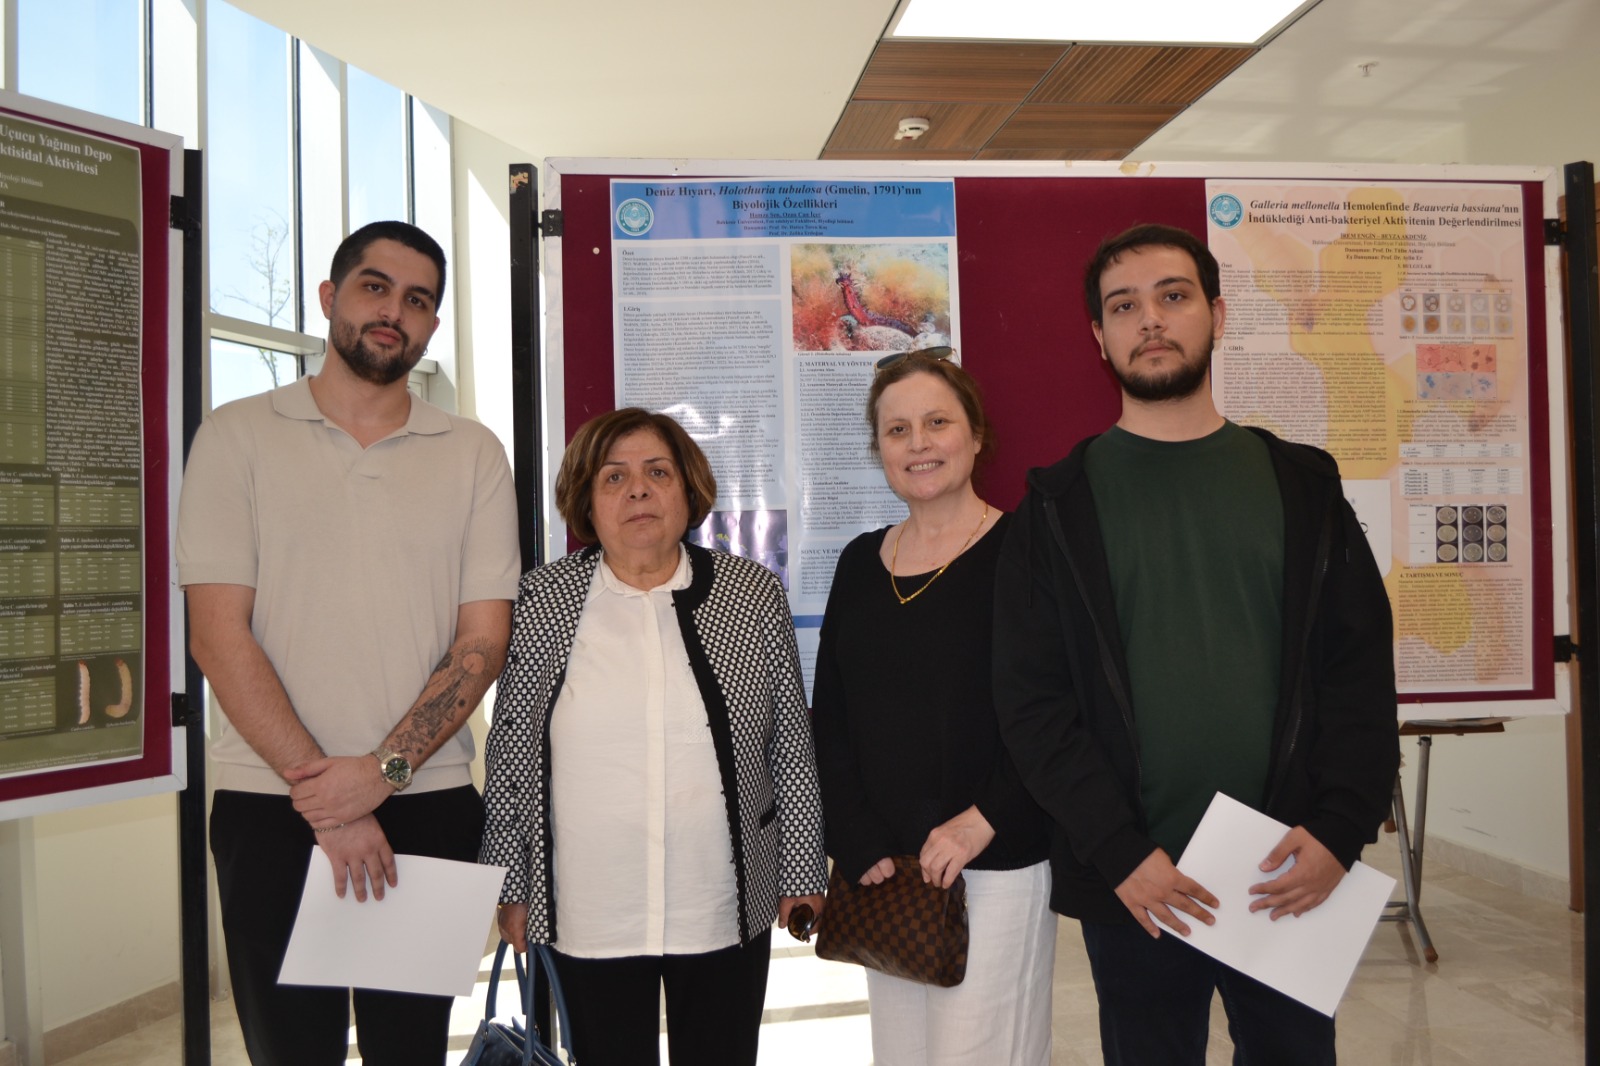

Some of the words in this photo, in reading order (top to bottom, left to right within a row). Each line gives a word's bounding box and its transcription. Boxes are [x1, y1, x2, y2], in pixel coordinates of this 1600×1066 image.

[0, 125, 36, 144] Uçucu
[39, 133, 81, 153] Yağının
[84, 144, 112, 163] Depo
[45, 154, 99, 176] Aktivitesi
[645, 186, 675, 198] Deniz
[679, 186, 716, 199] Hıyarı,
[719, 184, 775, 196] Holothuria
[778, 183, 822, 195] tubulosa
[825, 184, 870, 198] (Gmelin,
[732, 199, 780, 212] Biyolojik
[783, 197, 838, 210] Özellikleri
[1250, 199, 1289, 211] Galleria
[1291, 200, 1340, 212] mellonella
[1343, 201, 1410, 213] Hemolenfinde
[1413, 202, 1460, 214] Beauveria
[1248, 212, 1305, 227] İndüklediği
[1307, 214, 1381, 228] Anti-bakteriyel
[1383, 215, 1435, 227] Aktivitenin
[1438, 216, 1522, 229] Değerlendirilmesi
